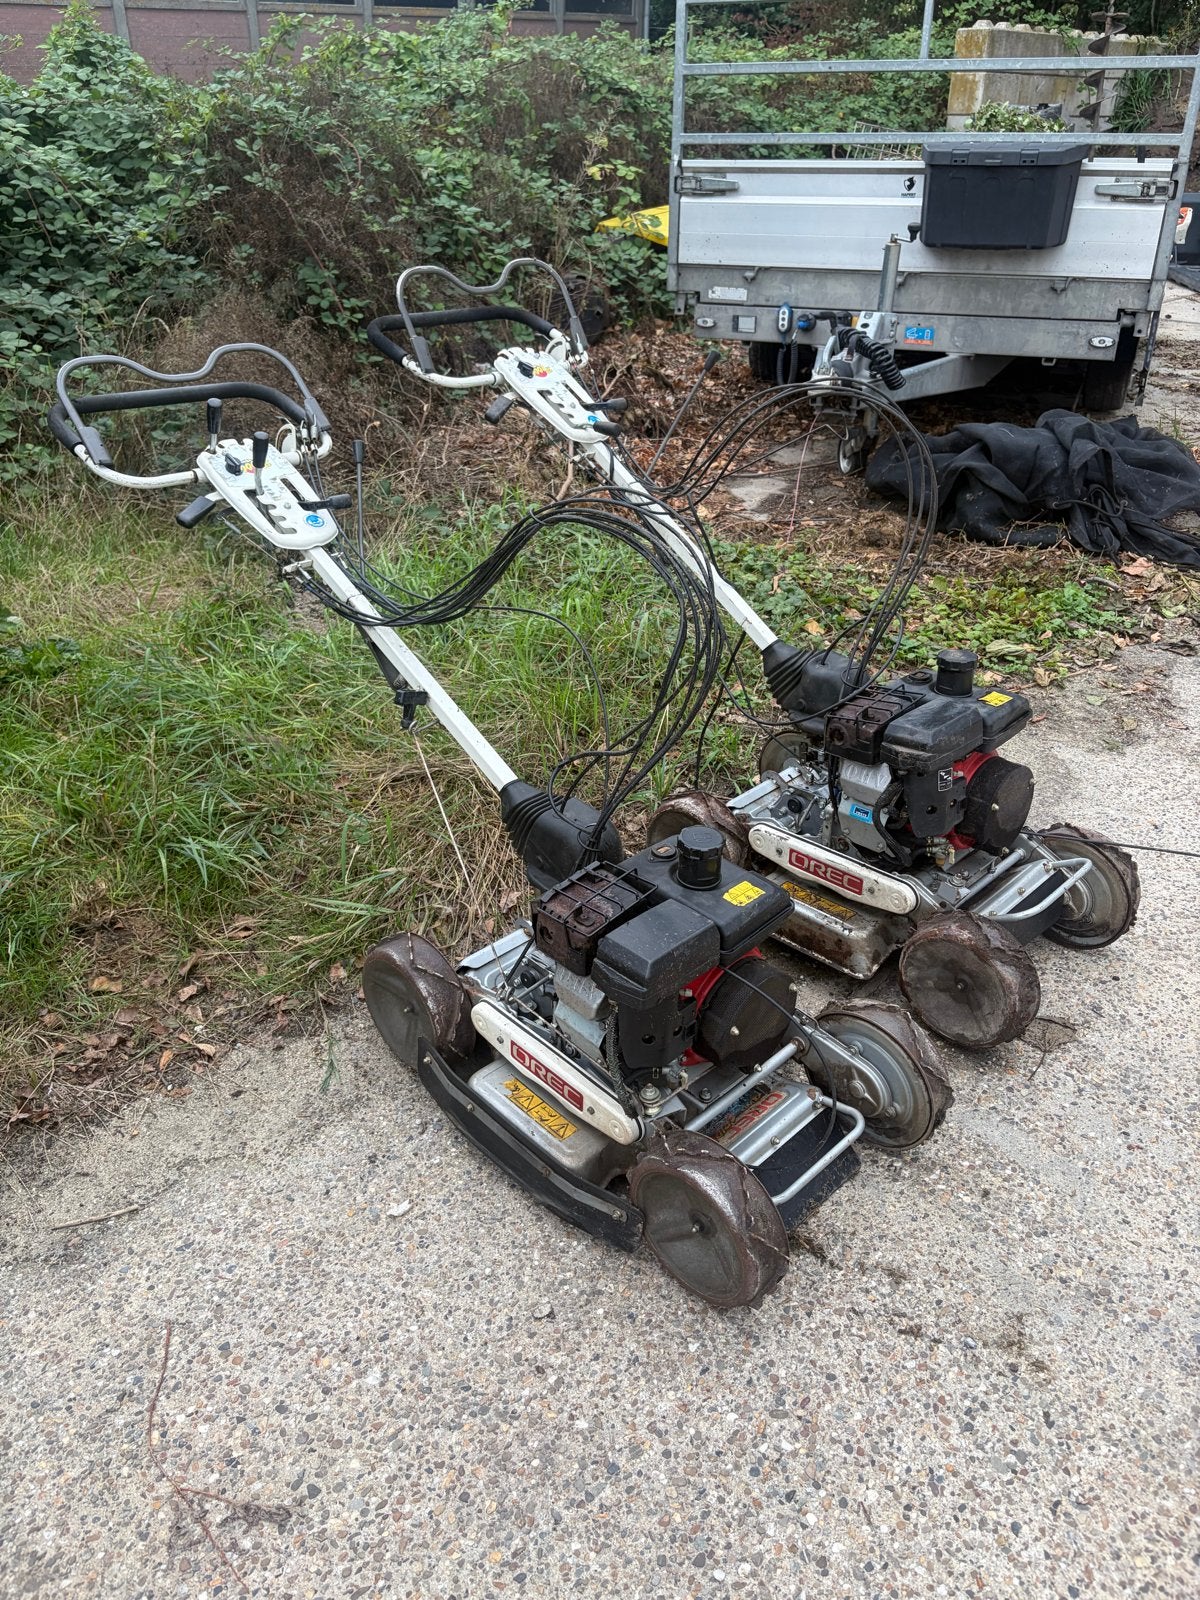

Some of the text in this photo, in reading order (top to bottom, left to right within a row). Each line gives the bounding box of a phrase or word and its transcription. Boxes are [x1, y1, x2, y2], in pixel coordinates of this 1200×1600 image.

[792, 852, 861, 892] OREC
[512, 1044, 581, 1107] OREC
[721, 1093, 784, 1140] OREC
